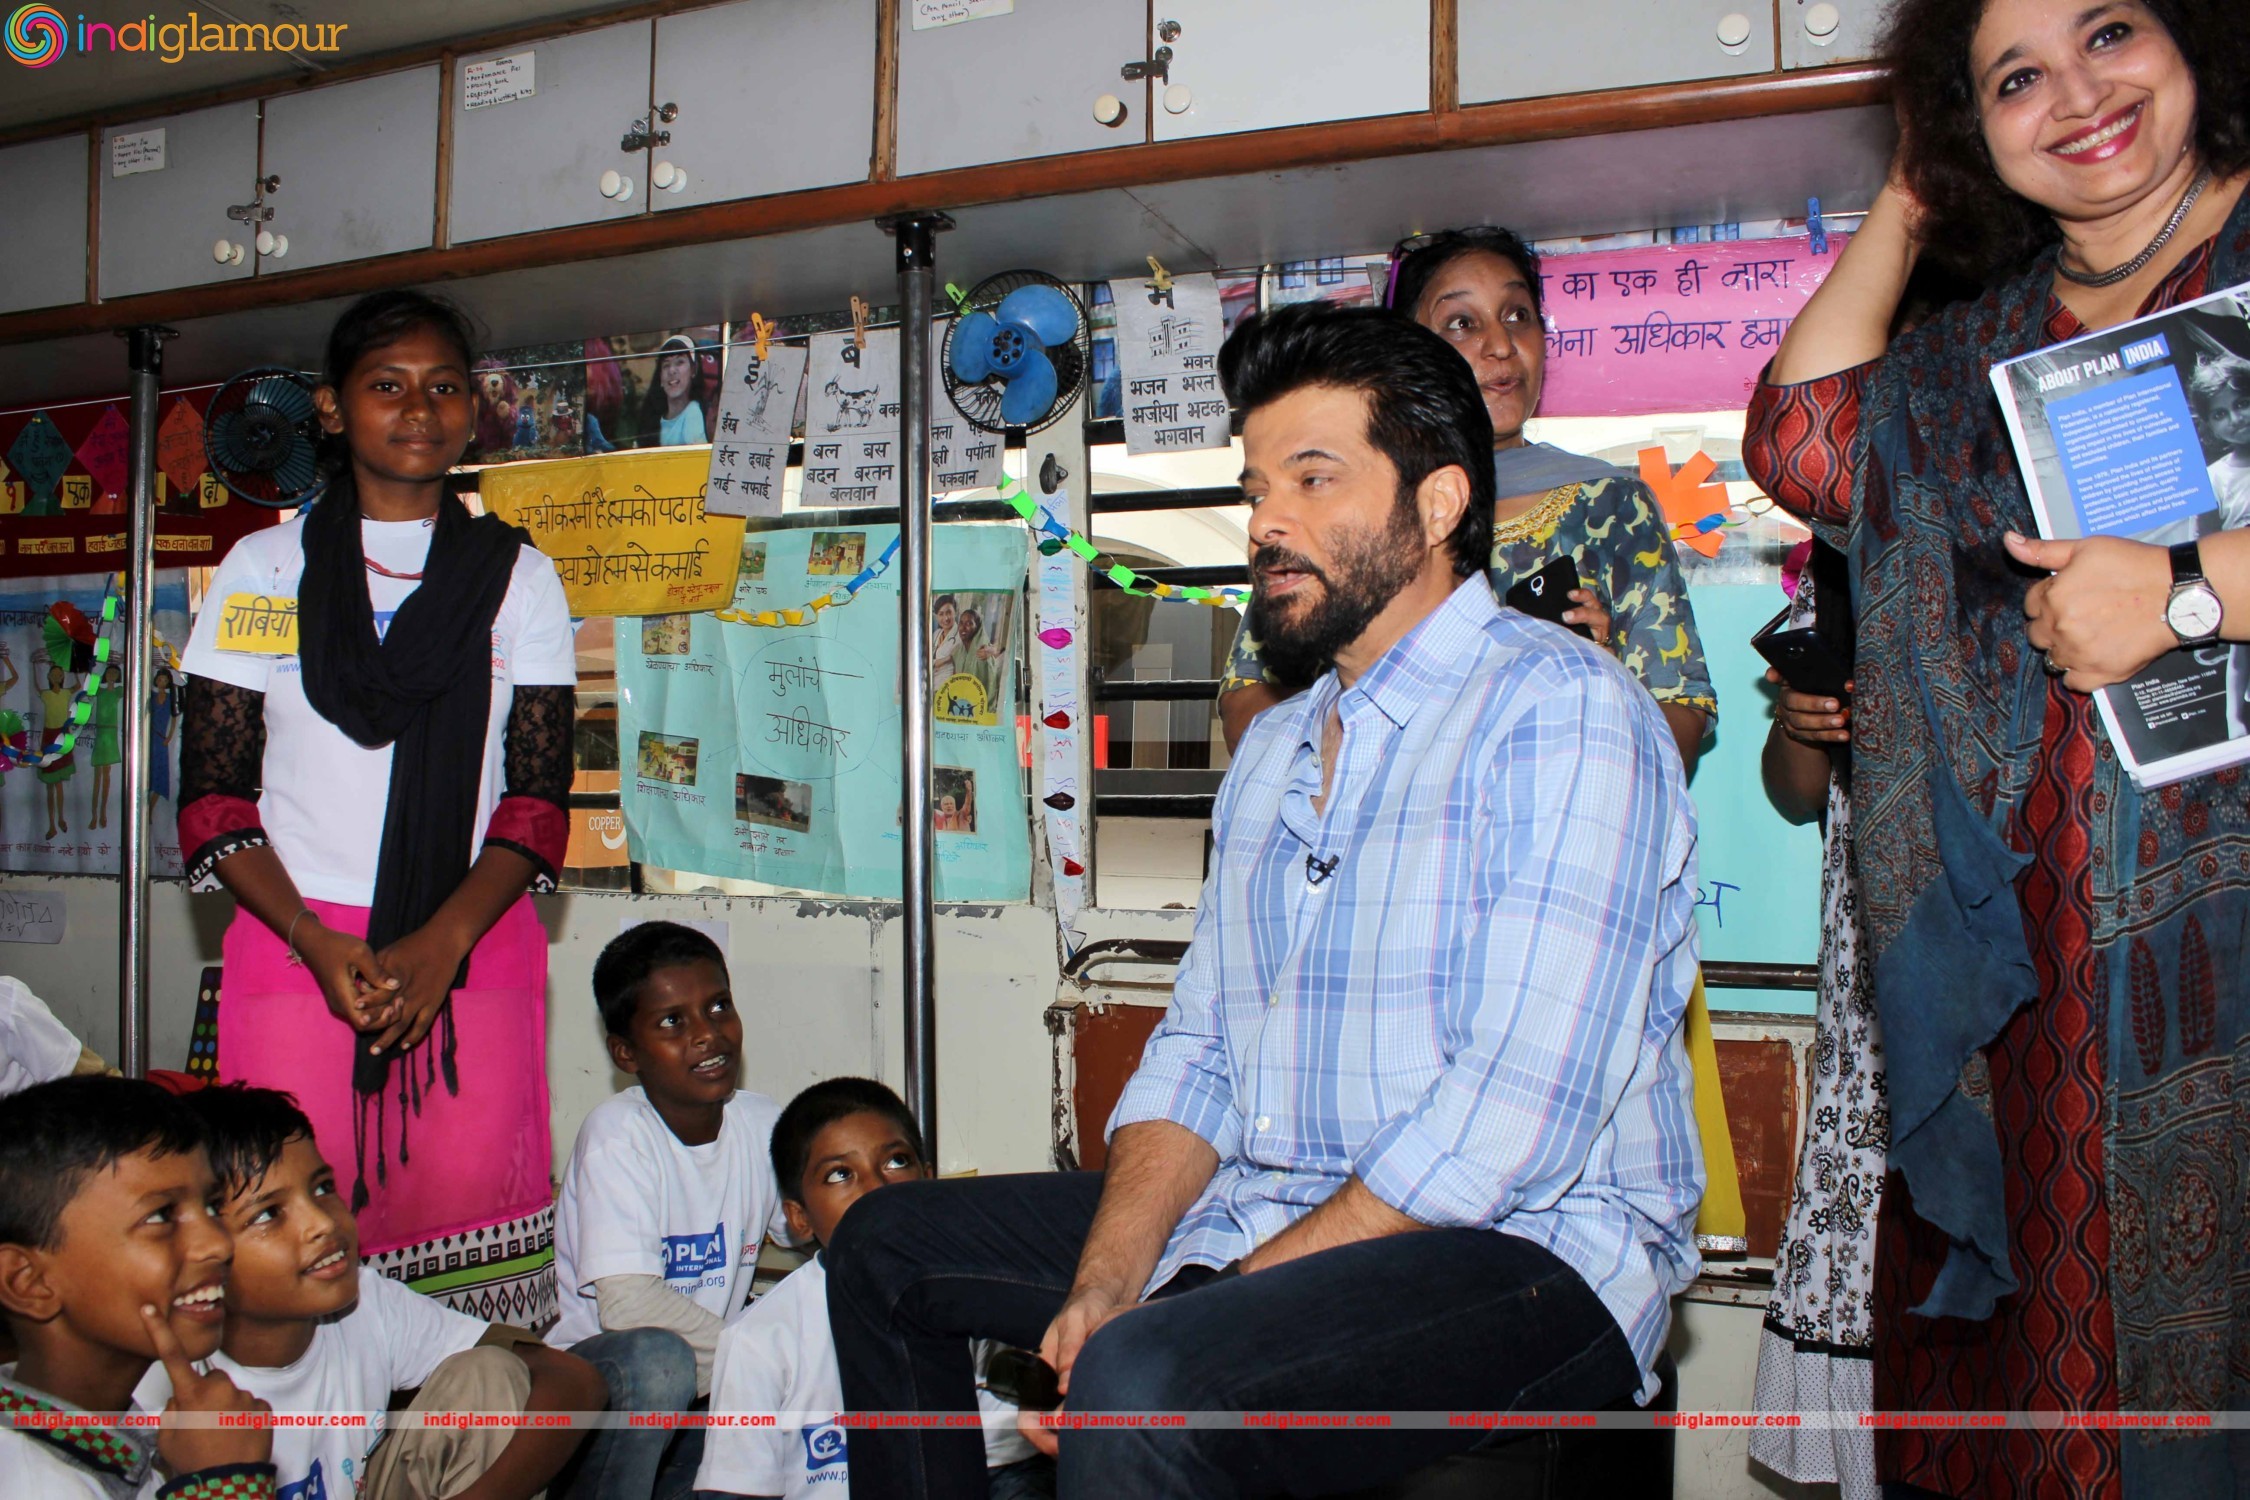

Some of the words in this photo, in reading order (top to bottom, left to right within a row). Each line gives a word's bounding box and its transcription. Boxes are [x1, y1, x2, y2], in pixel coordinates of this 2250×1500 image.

[1563, 273, 1599, 300] का
[1609, 270, 1657, 297] एक
[1675, 259, 1708, 297] ही
[1722, 259, 1795, 293] नारा
[1611, 310, 1732, 355] अधिकार
[1183, 354, 1216, 370] भवन
[2038, 365, 2082, 393] ABOUT
[2082, 353, 2120, 379] PLAN
[2123, 340, 2164, 365] INDIA
[1130, 378, 1168, 396] भजन
[1182, 374, 1217, 392] भरत
[721, 411, 741, 434] ईख
[1132, 400, 1179, 424] भजीया
[1187, 400, 1226, 420] भटक
[1154, 425, 1205, 446] भगवान
[719, 444, 740, 467] ईद
[749, 447, 775, 470] दवाई
[813, 443, 842, 460] बल
[863, 441, 891, 459] बस
[965, 441, 997, 462] पपीता
[713, 472, 736, 495] राई
[741, 476, 772, 500] सफाई
[806, 467, 840, 485] बदन
[854, 464, 895, 482] बरतन
[938, 469, 979, 487] पकवान
[829, 485, 878, 502] बलवान
[764, 656, 864, 697] मुलांचे
[765, 705, 851, 759] अधिकार
[588, 816, 621, 831] COPPER
[675, 1234, 721, 1263] PLAN
